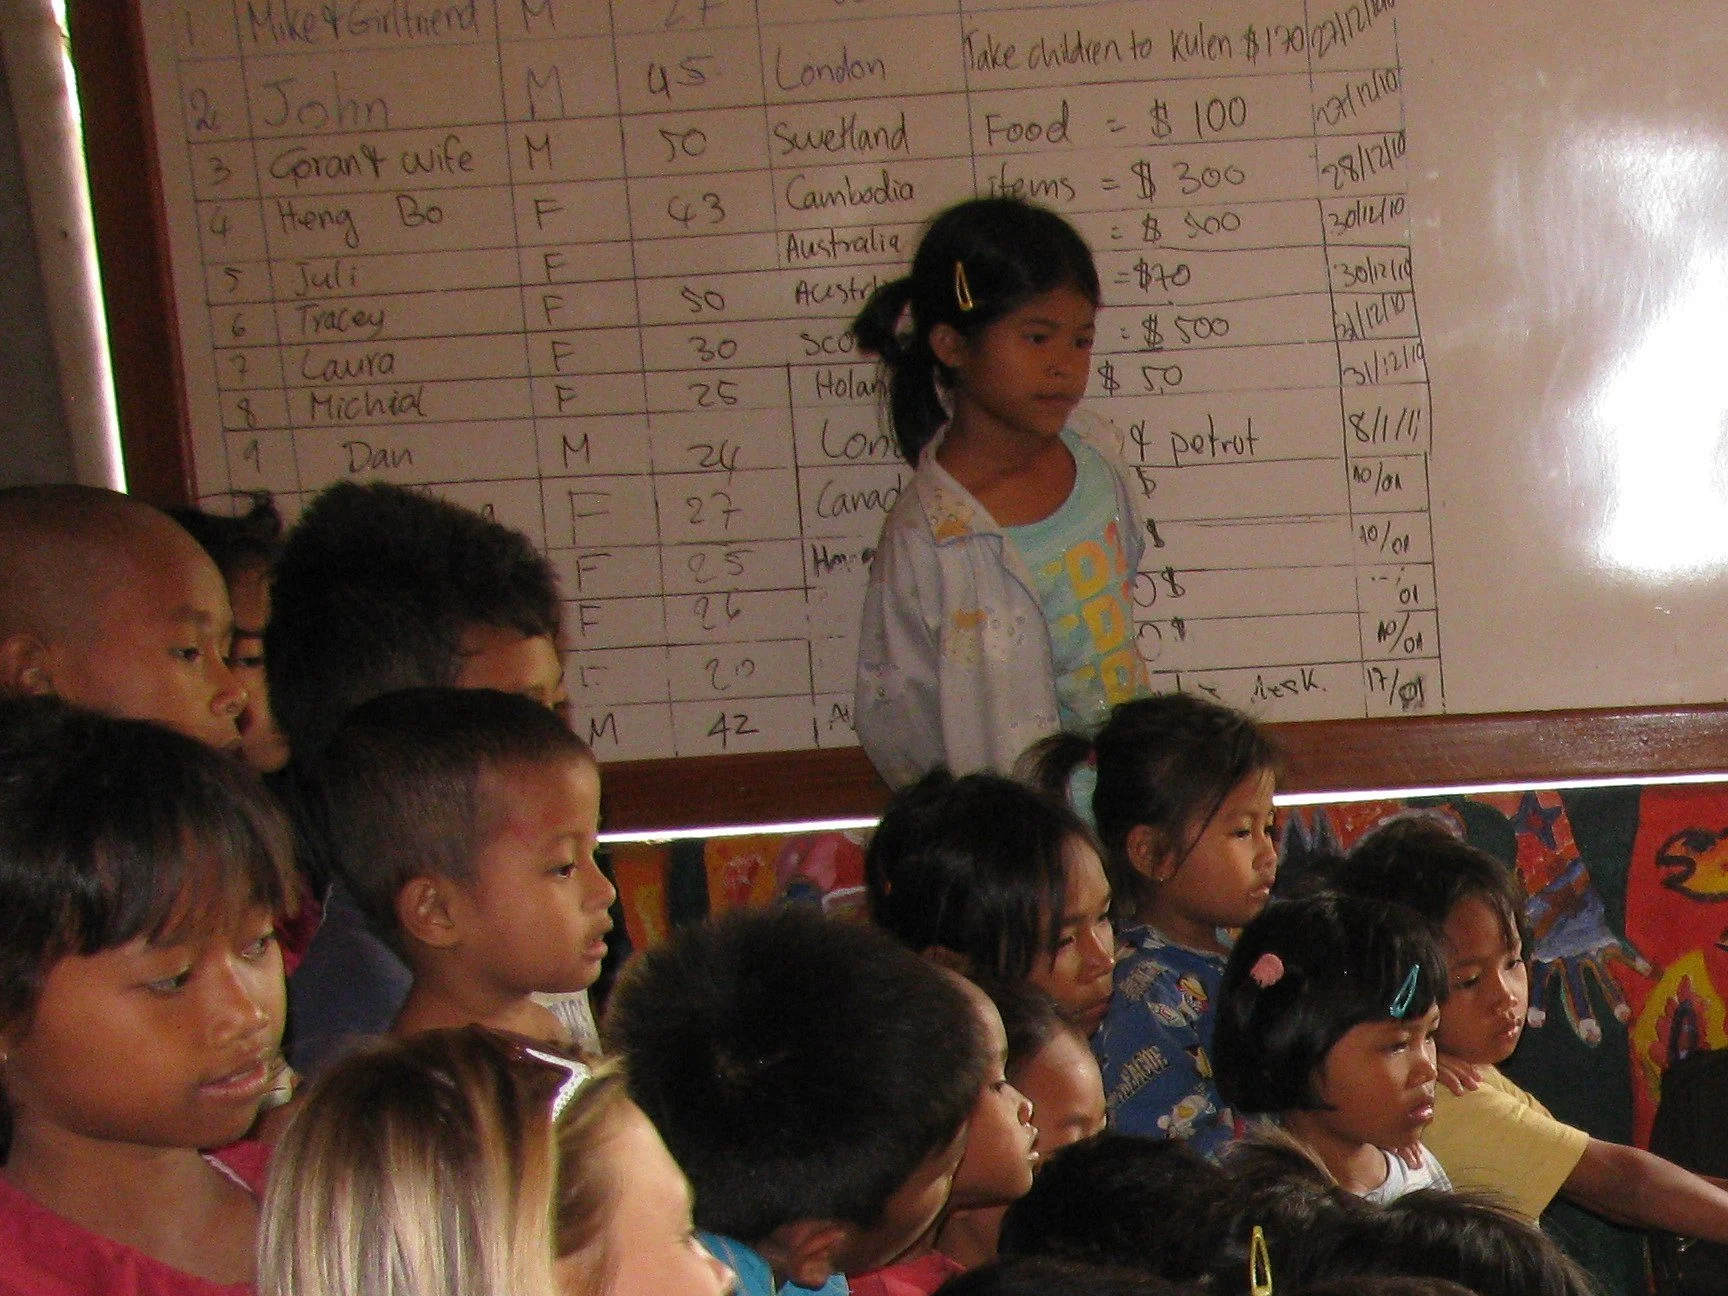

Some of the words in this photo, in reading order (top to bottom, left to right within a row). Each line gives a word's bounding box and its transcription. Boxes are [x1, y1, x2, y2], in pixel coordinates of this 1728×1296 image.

[262, 69, 389, 130] John
[527, 65, 566, 120] M
[647, 55, 714, 100] 45
[774, 46, 886, 92] London
[963, 28, 1013, 72] Take
[1028, 35, 1123, 68] children
[1130, 28, 1153, 60] to
[209, 157, 232, 185] 3
[401, 134, 475, 176] wife
[523, 132, 553, 170] M
[658, 128, 708, 162] 50
[985, 100, 1069, 146] Food
[1193, 96, 1248, 140] 100
[208, 214, 232, 238] 4
[396, 194, 443, 228] Bo
[533, 197, 564, 231] F
[667, 192, 726, 230] 43
[786, 168, 914, 211] Cambodia
[1173, 162, 1247, 196] 300
[543, 252, 568, 283] F
[786, 227, 900, 263] Australia
[294, 300, 385, 341] Tracey
[542, 294, 564, 325] F
[301, 347, 395, 382] Laura
[551, 340, 575, 372] F
[688, 336, 738, 362] 30
[1173, 315, 1230, 345] 500
[554, 384, 578, 412] F
[688, 380, 738, 407] 25
[814, 368, 889, 400] Holan
[341, 440, 414, 474] Dan
[561, 431, 591, 470] M
[567, 489, 612, 546] F
[686, 490, 743, 531] 27
[817, 473, 905, 518] Canad
[575, 552, 613, 593] F
[687, 549, 754, 585] 25
[578, 603, 602, 637] F
[705, 657, 756, 691] 20
[590, 712, 619, 746] M
[706, 711, 760, 749] 42
